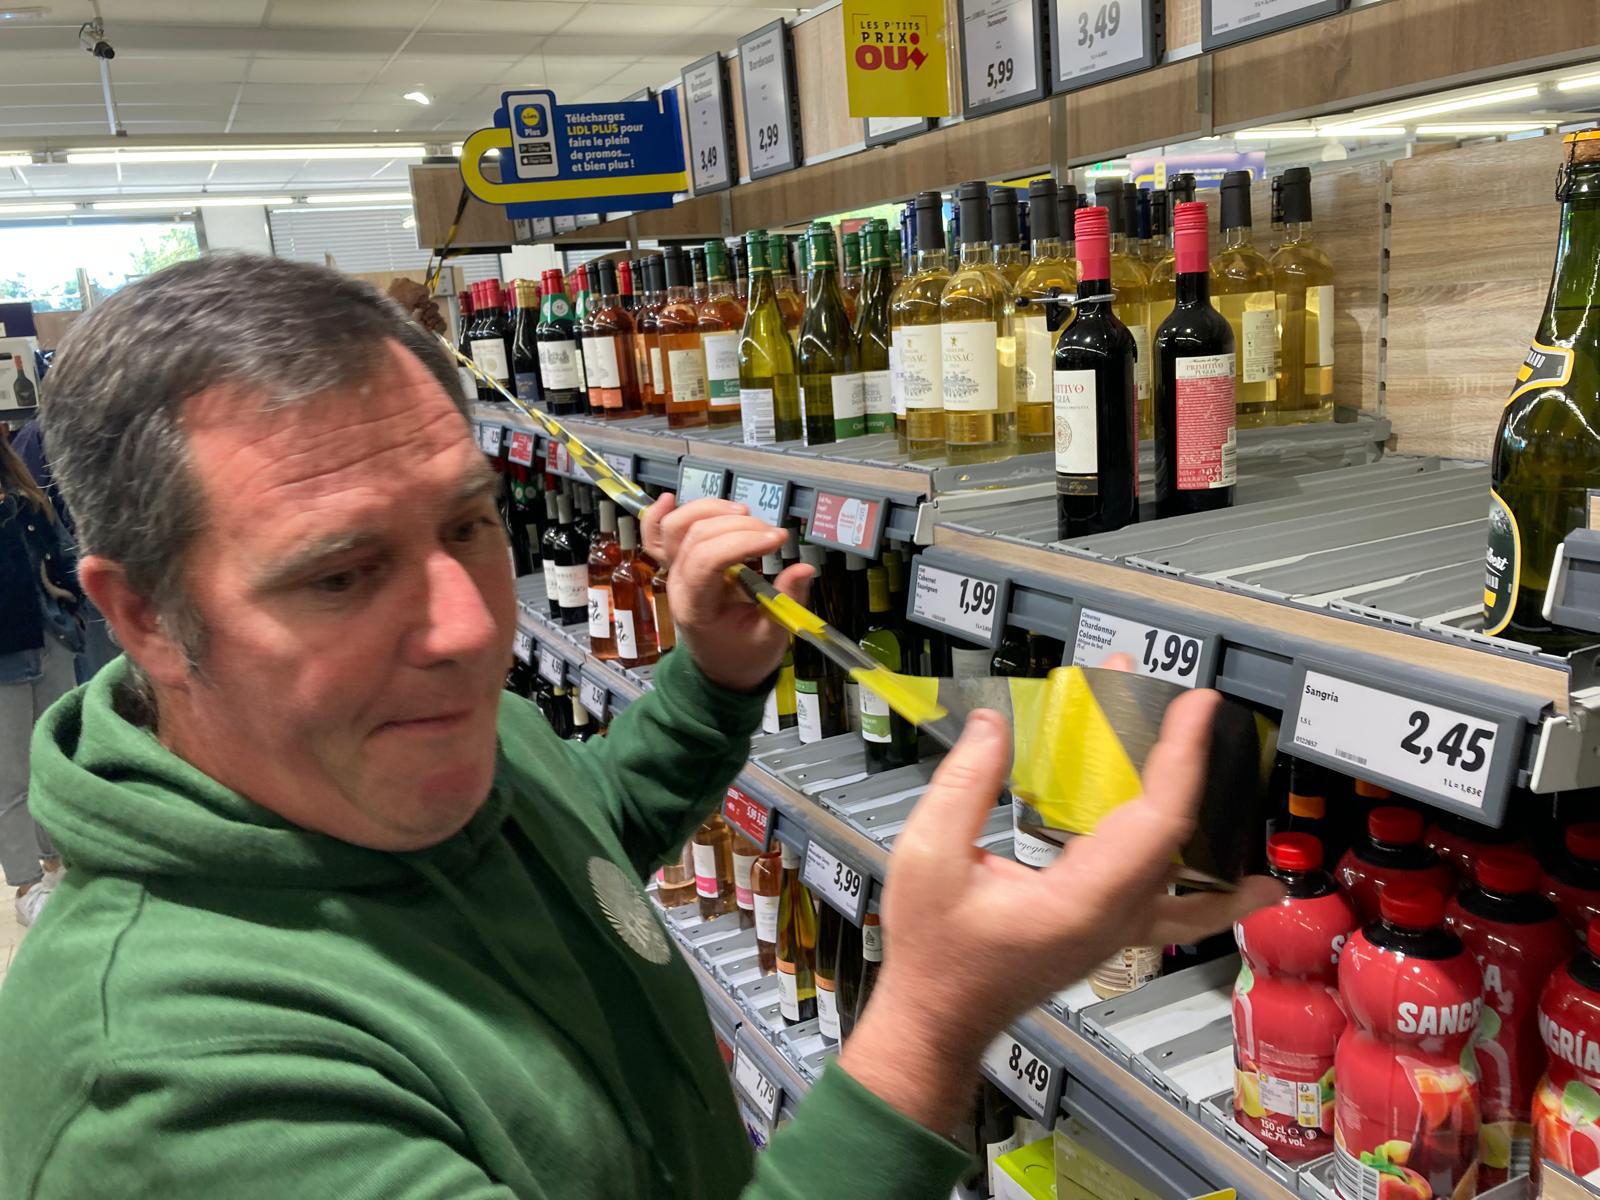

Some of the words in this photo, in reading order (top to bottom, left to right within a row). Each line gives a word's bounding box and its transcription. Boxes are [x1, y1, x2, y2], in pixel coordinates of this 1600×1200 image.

[860, 21, 879, 29] LES
[1077, 1, 1121, 48] 3,49
[861, 31, 907, 43] PRIX
[986, 57, 1014, 89] 5,99
[565, 113, 625, 124] Téléchargez
[567, 125, 591, 136] LIDL
[591, 123, 619, 134] PLUS
[620, 124, 644, 135] pour
[759, 122, 779, 152] 2,99
[568, 137, 592, 148] faire
[593, 136, 603, 146] le
[604, 134, 630, 148] plein
[570, 150, 584, 160] de
[585, 149, 631, 162] promos...
[700, 145, 718, 172] 3,49
[571, 162, 582, 172] et
[583, 160, 606, 172] bien
[607, 159, 629, 172] plus
[758, 483, 784, 511] 2,25
[959, 578, 996, 615] 1,99
[1078, 629, 1112, 646] Colombard
[1080, 619, 1117, 638] Chardonnay
[1143, 629, 1200, 678] 1,99
[1305, 684, 1339, 703] Sangria
[1400, 709, 1495, 773] 2,45
[1448, 779, 1453, 788] L
[833, 862, 861, 898] 3,99
[1008, 1042, 1049, 1092] 8,49
[756, 1072, 775, 1104] 7,79
[1260, 1118, 1276, 1132] 150
[1288, 1137, 1306, 1148] vol.
